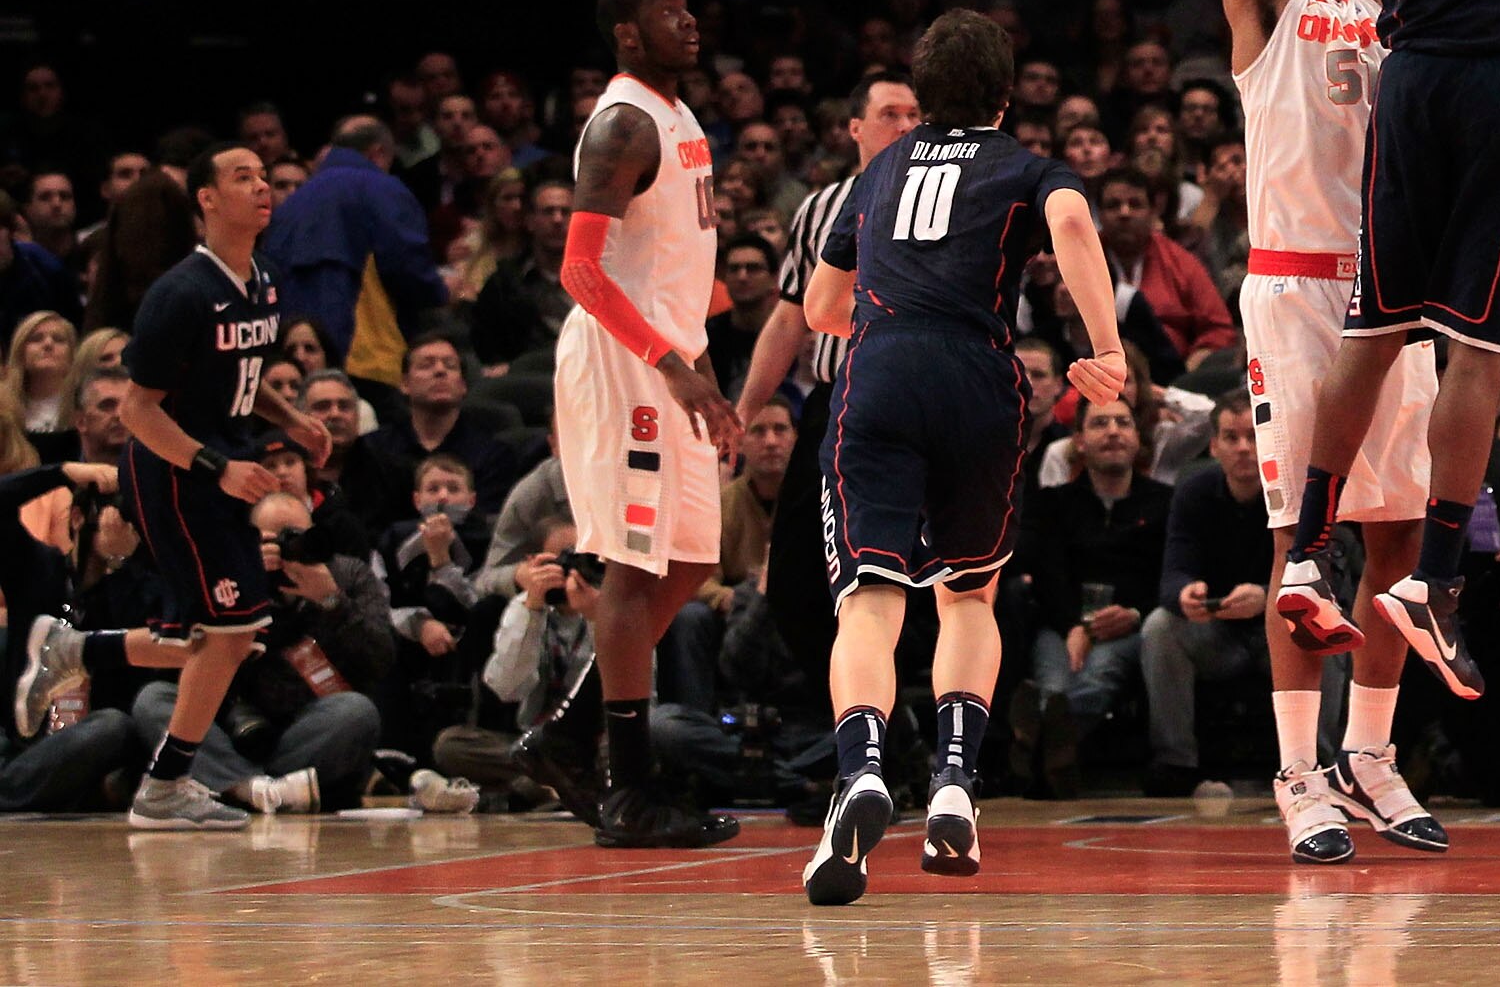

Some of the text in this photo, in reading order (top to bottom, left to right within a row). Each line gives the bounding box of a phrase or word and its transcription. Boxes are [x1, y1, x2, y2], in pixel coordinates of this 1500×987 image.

[909, 140, 980, 161] OLANDER
[892, 163, 962, 241] 10
[632, 406, 658, 441] S
